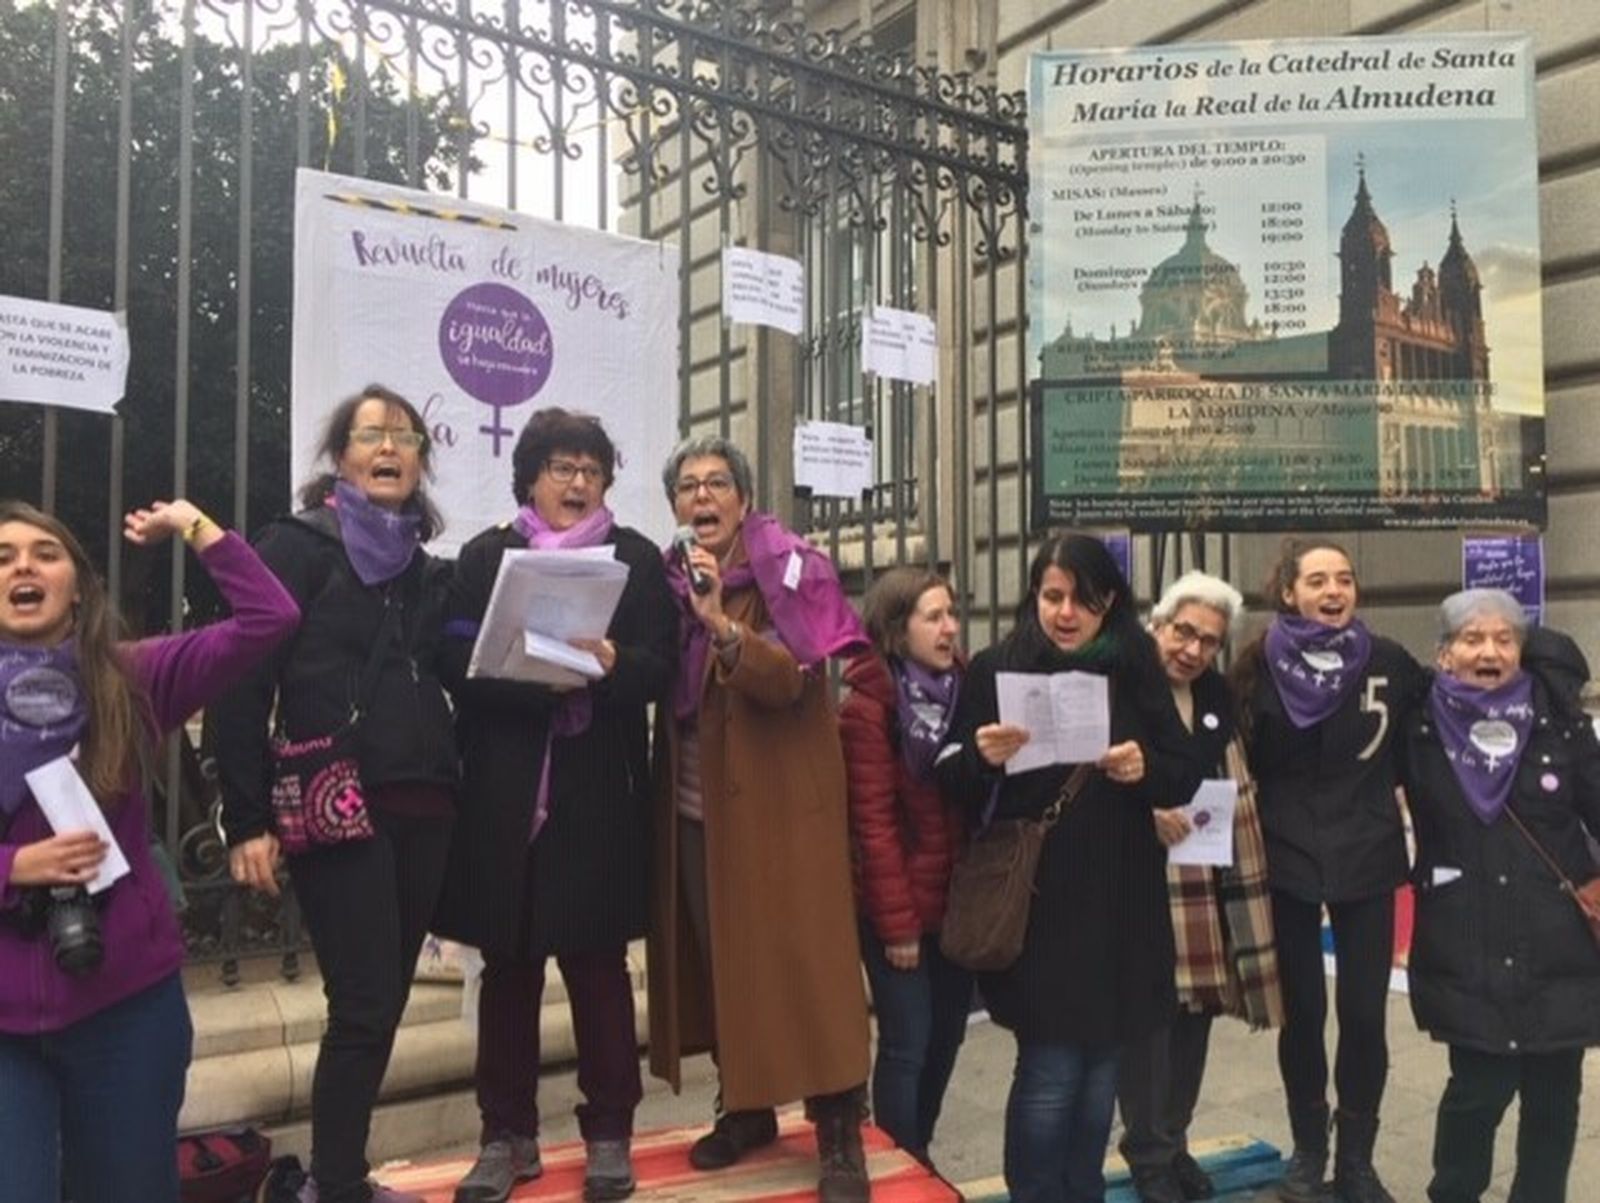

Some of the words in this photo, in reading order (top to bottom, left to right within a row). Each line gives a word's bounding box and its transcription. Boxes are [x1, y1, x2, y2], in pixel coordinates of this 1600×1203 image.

[1052, 57, 1198, 86] Horarios
[1206, 60, 1232, 78] de
[1240, 58, 1260, 75] la
[1268, 49, 1390, 74] Catedral
[1398, 52, 1425, 69] de
[1431, 48, 1515, 69] Santa
[1072, 98, 1157, 123] María
[1165, 100, 1186, 117] la
[1195, 92, 1257, 116] Real
[1264, 94, 1291, 112] de
[1298, 93, 1319, 111] la
[1325, 83, 1497, 109] Almudena
[1089, 146, 1174, 161] APERTURA
[1178, 144, 1208, 157] DEL
[1215, 140, 1286, 154] TEMPLO:
[1189, 157, 1207, 168] de
[1211, 156, 1246, 167] 9:00
[1250, 156, 1258, 165] a
[1263, 154, 1306, 166] 20:30
[1051, 188, 1106, 201] MISAS:
[1110, 185, 1168, 199] (Masses)
[1074, 210, 1093, 222] De
[1096, 208, 1141, 220] Lunes
[1144, 209, 1153, 218] a
[1261, 202, 1302, 213] 12:00
[1076, 224, 1132, 239] (Monday
[1261, 217, 1303, 228] 18:00
[1262, 232, 1303, 244] 19:00
[351, 229, 466, 273] Revuelta
[491, 246, 521, 278] de
[536, 264, 630, 319] mujeres
[1074, 267, 1148, 281] Domingos
[1264, 261, 1305, 271] 10:30
[1264, 273, 1305, 284] 12:00
[1264, 303, 1306, 314] 18:00
[30, 317, 56, 330] QUE
[59, 321, 71, 333] SE
[20, 334, 34, 343] LA
[38, 334, 100, 354] VIOLENCIA
[449, 320, 550, 356] igualdad
[12, 364, 27, 375] LA
[30, 365, 86, 381] POBREZA
[1268, 384, 1328, 399] SANTA
[1168, 406, 1190, 420] LA
[1200, 404, 1296, 419] ALMUDENA
